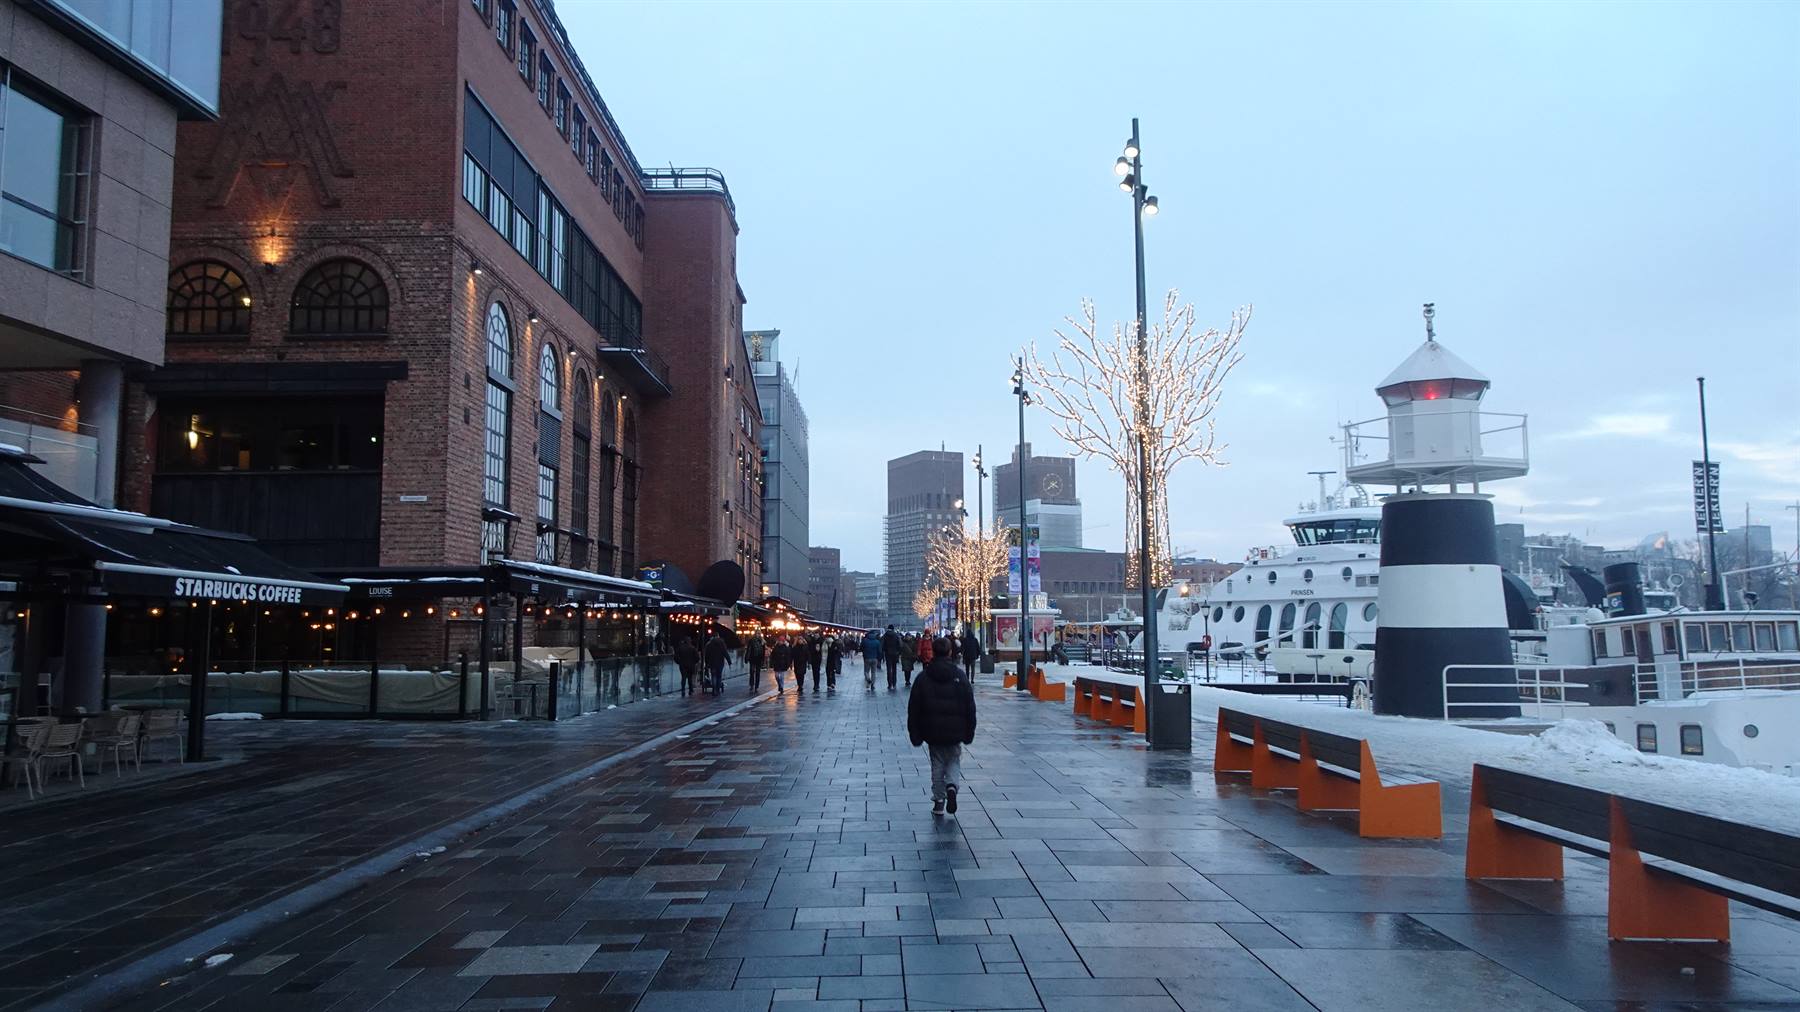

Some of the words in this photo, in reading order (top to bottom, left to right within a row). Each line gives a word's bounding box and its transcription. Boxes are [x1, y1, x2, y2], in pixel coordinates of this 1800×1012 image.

[175, 577, 257, 600] STARBUCKS
[258, 585, 302, 604] COFFEE
[369, 587, 393, 595] LOUISE
